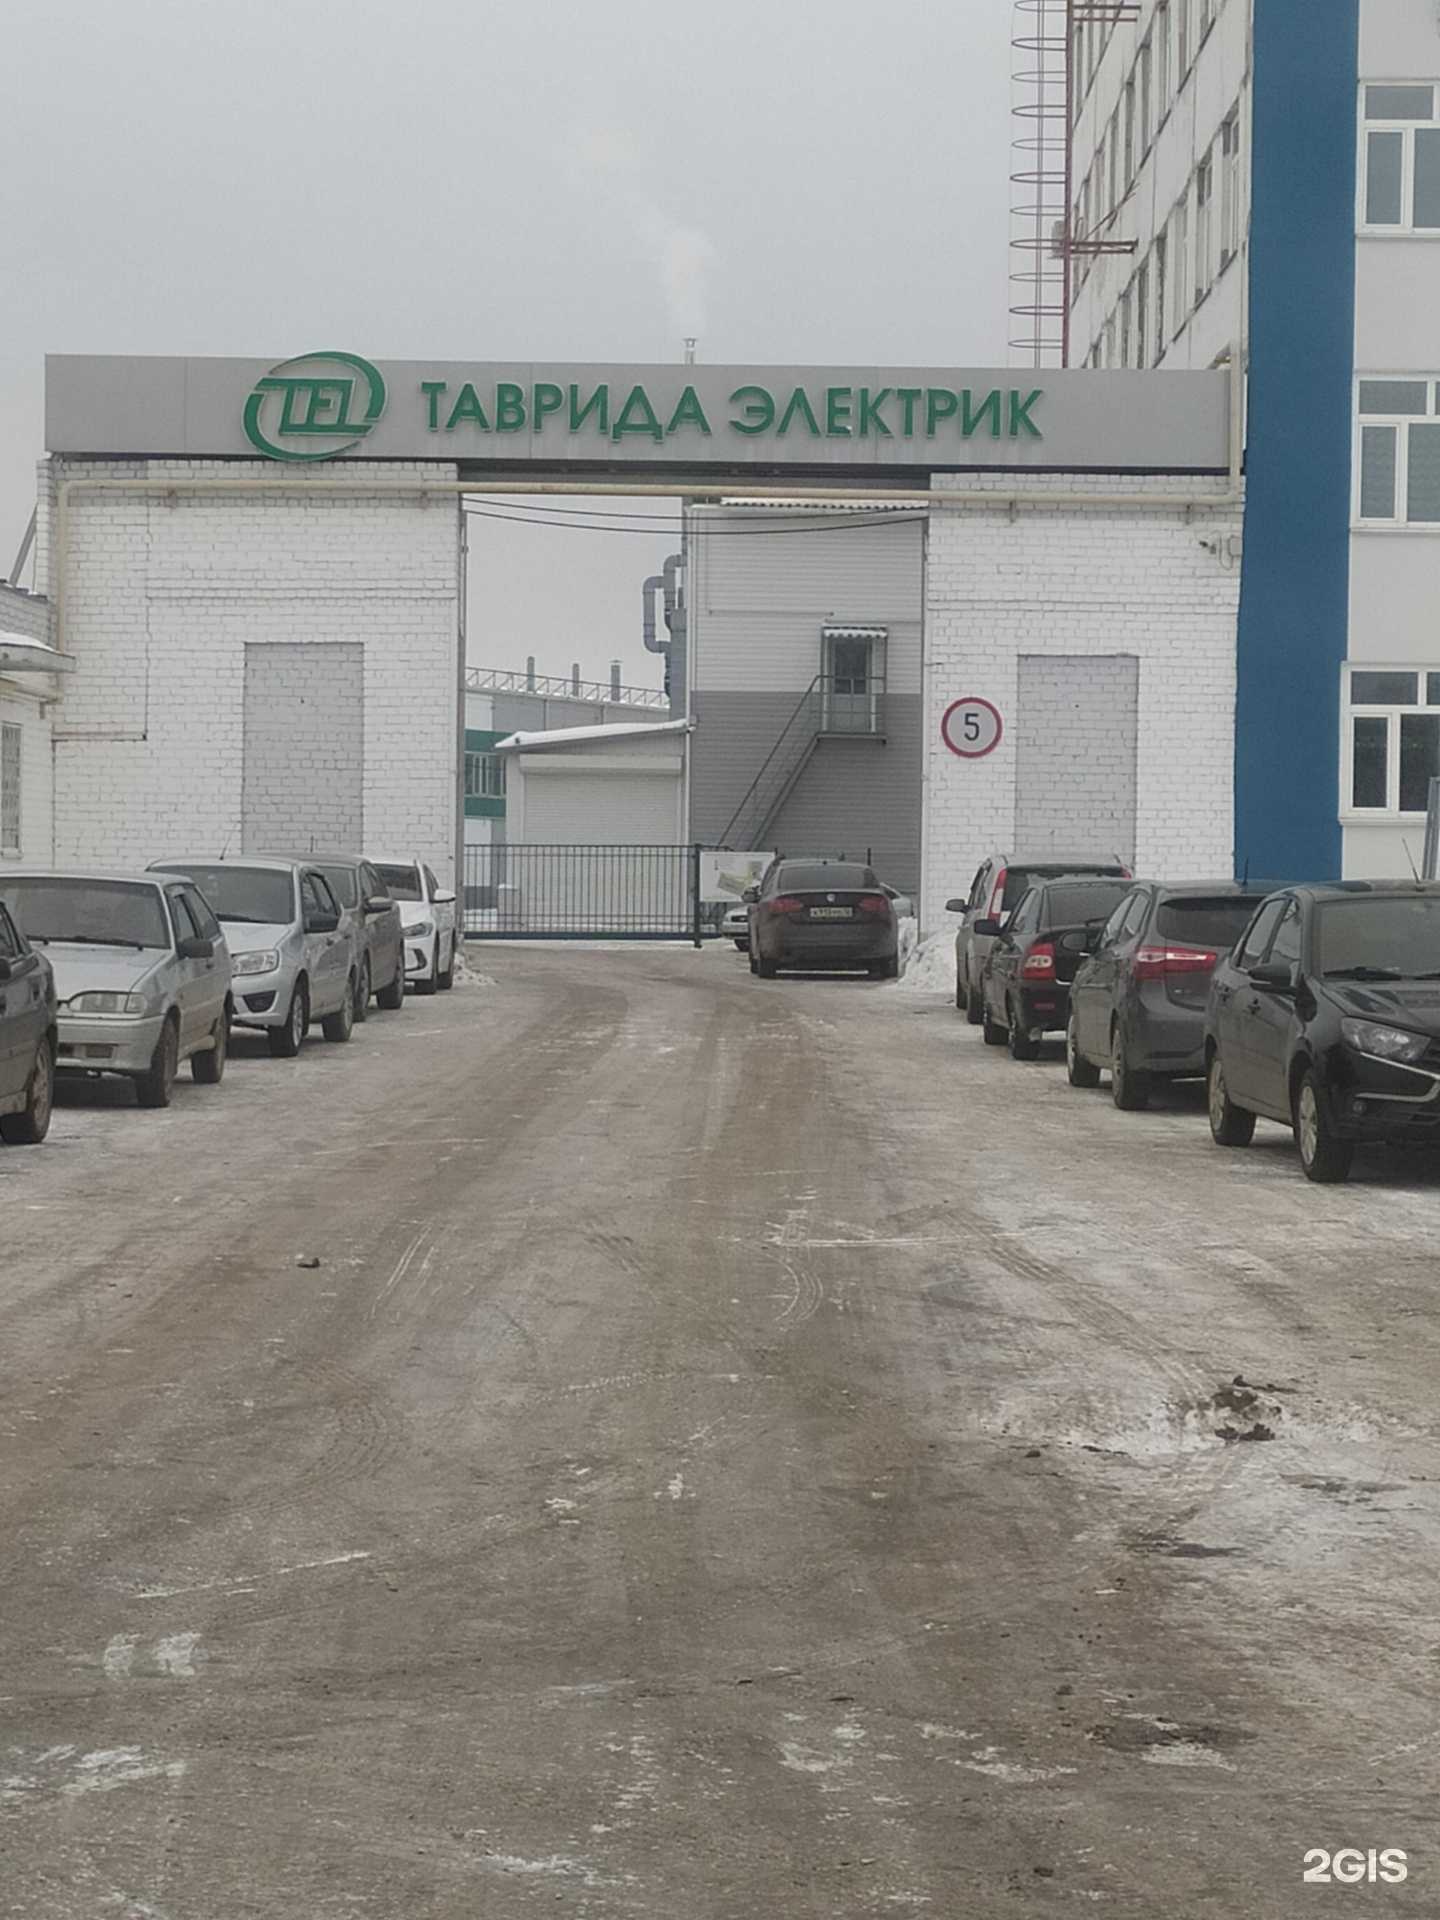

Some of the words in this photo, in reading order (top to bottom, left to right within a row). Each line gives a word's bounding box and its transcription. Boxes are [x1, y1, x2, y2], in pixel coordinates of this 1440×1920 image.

[421, 382, 711, 442] ТАВРИДА
[729, 386, 1044, 438] ЭЛЕКТРИК
[964, 712, 980, 741] 5
